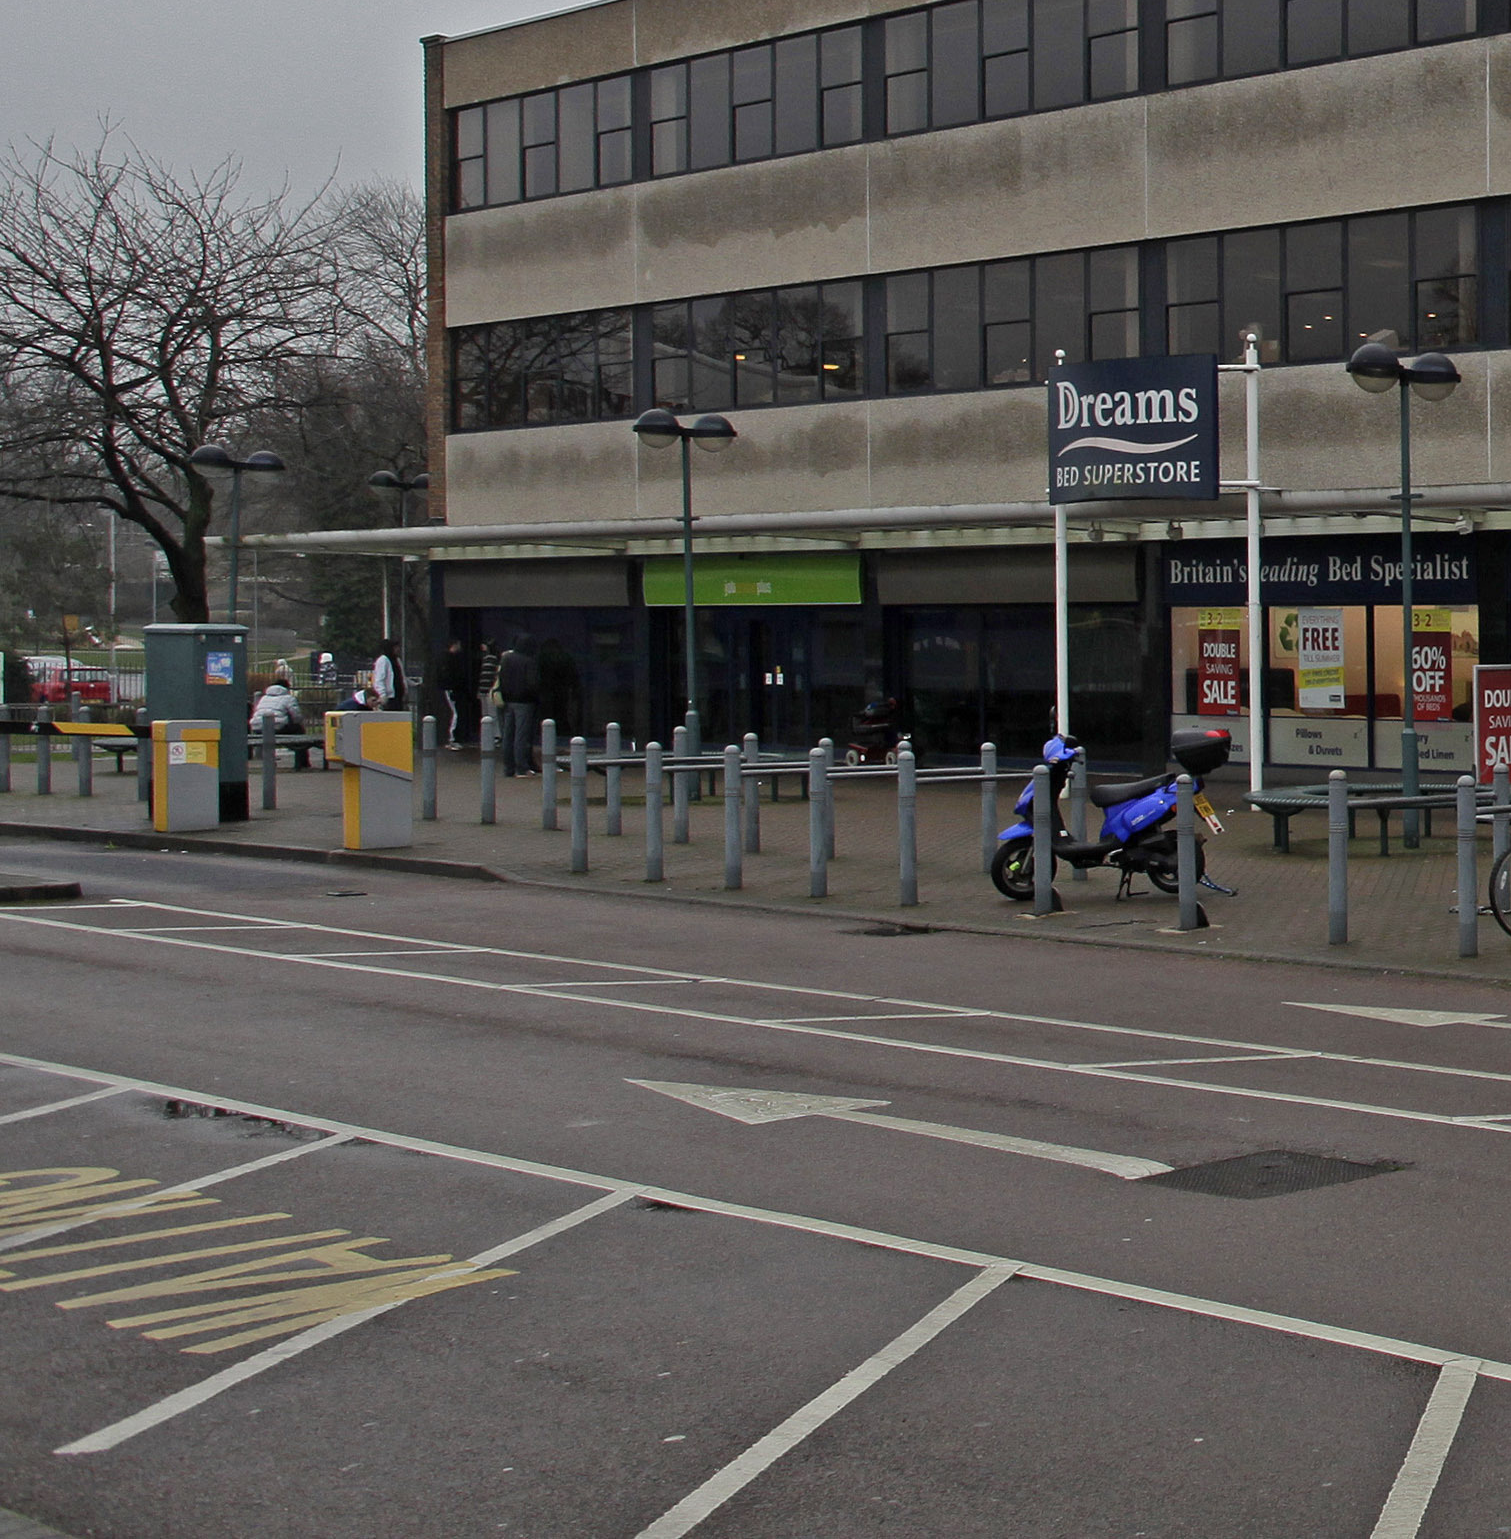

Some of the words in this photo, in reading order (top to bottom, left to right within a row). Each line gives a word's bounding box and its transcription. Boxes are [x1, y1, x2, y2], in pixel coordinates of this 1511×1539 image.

[1056, 381, 1199, 429] Dreams
[1056, 466, 1079, 488] BED
[1083, 461, 1201, 485] SUPERSTORE
[1170, 559, 1247, 583] Britain's
[1260, 557, 1319, 586] eading
[1328, 556, 1362, 581] Bed
[1425, 614, 1432, 627] 2
[1302, 627, 1340, 651] FREE
[1203, 642, 1236, 658] DOUBLE
[1206, 663, 1233, 675] SAVING
[1412, 671, 1445, 693] OFF
[1203, 680, 1236, 704] SALE
[1296, 728, 1322, 739] Pillows
[1316, 745, 1343, 756] Duvets
[1419, 749, 1430, 759] ed
[1432, 749, 1454, 760] Linen
